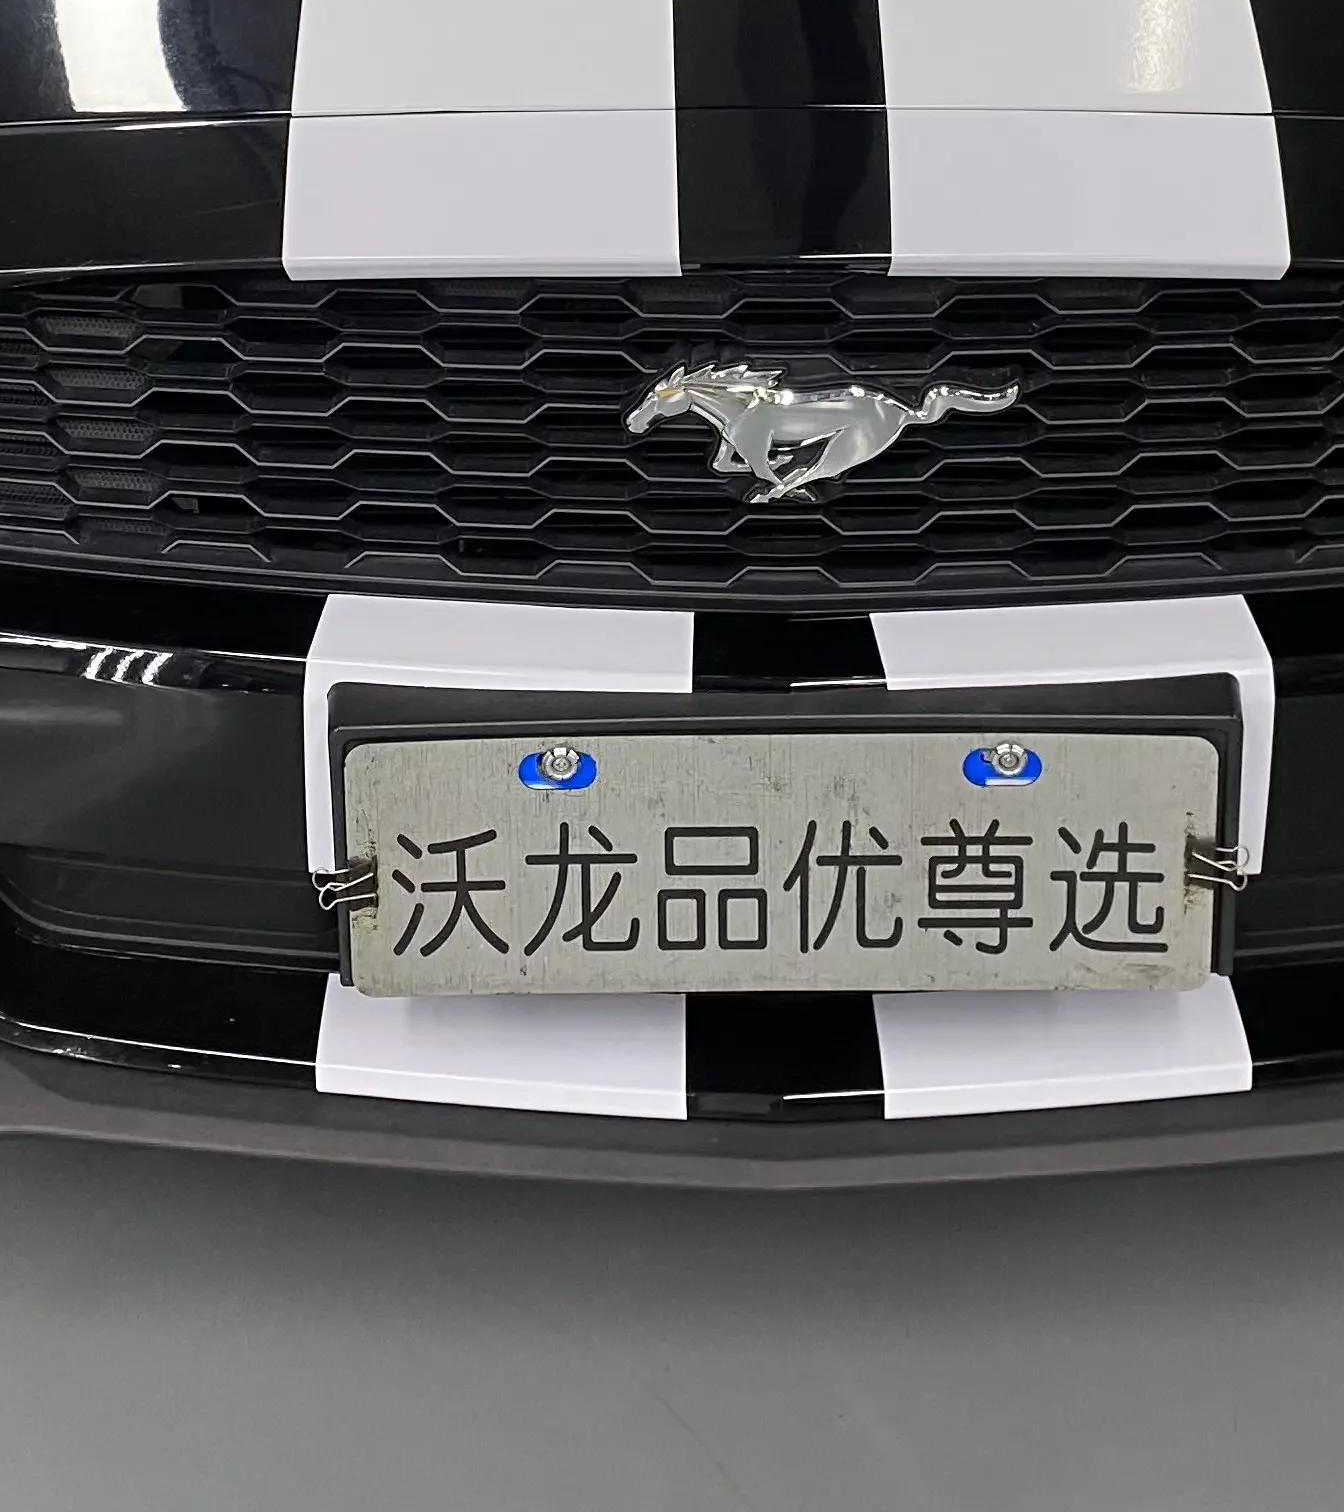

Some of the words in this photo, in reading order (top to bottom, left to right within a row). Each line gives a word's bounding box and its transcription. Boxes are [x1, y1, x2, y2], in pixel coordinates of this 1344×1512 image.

[391, 818, 1169, 958] 沃龙品优尊选
